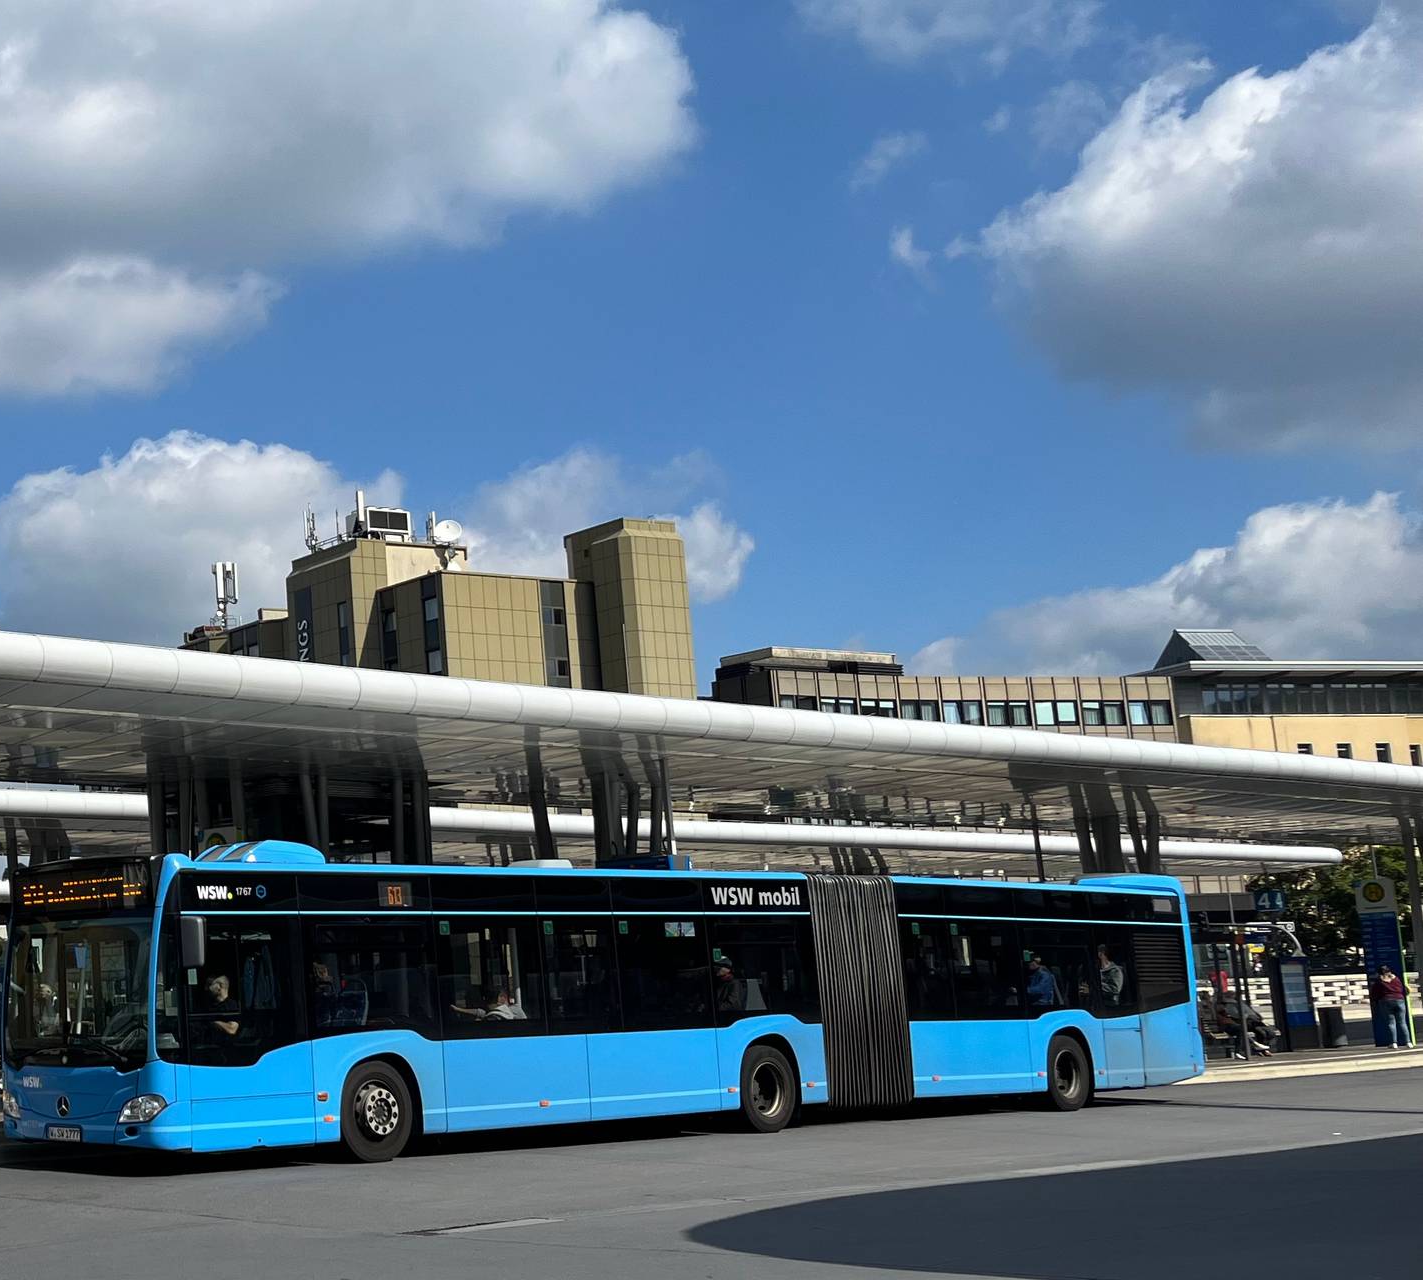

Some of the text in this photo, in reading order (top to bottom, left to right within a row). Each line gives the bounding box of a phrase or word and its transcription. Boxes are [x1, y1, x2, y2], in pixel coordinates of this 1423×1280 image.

[235, 886, 252, 896] 1767
[387, 886, 402, 905] 613
[710, 886, 801, 906] WSW mobil
[1257, 892, 1271, 909] 4
